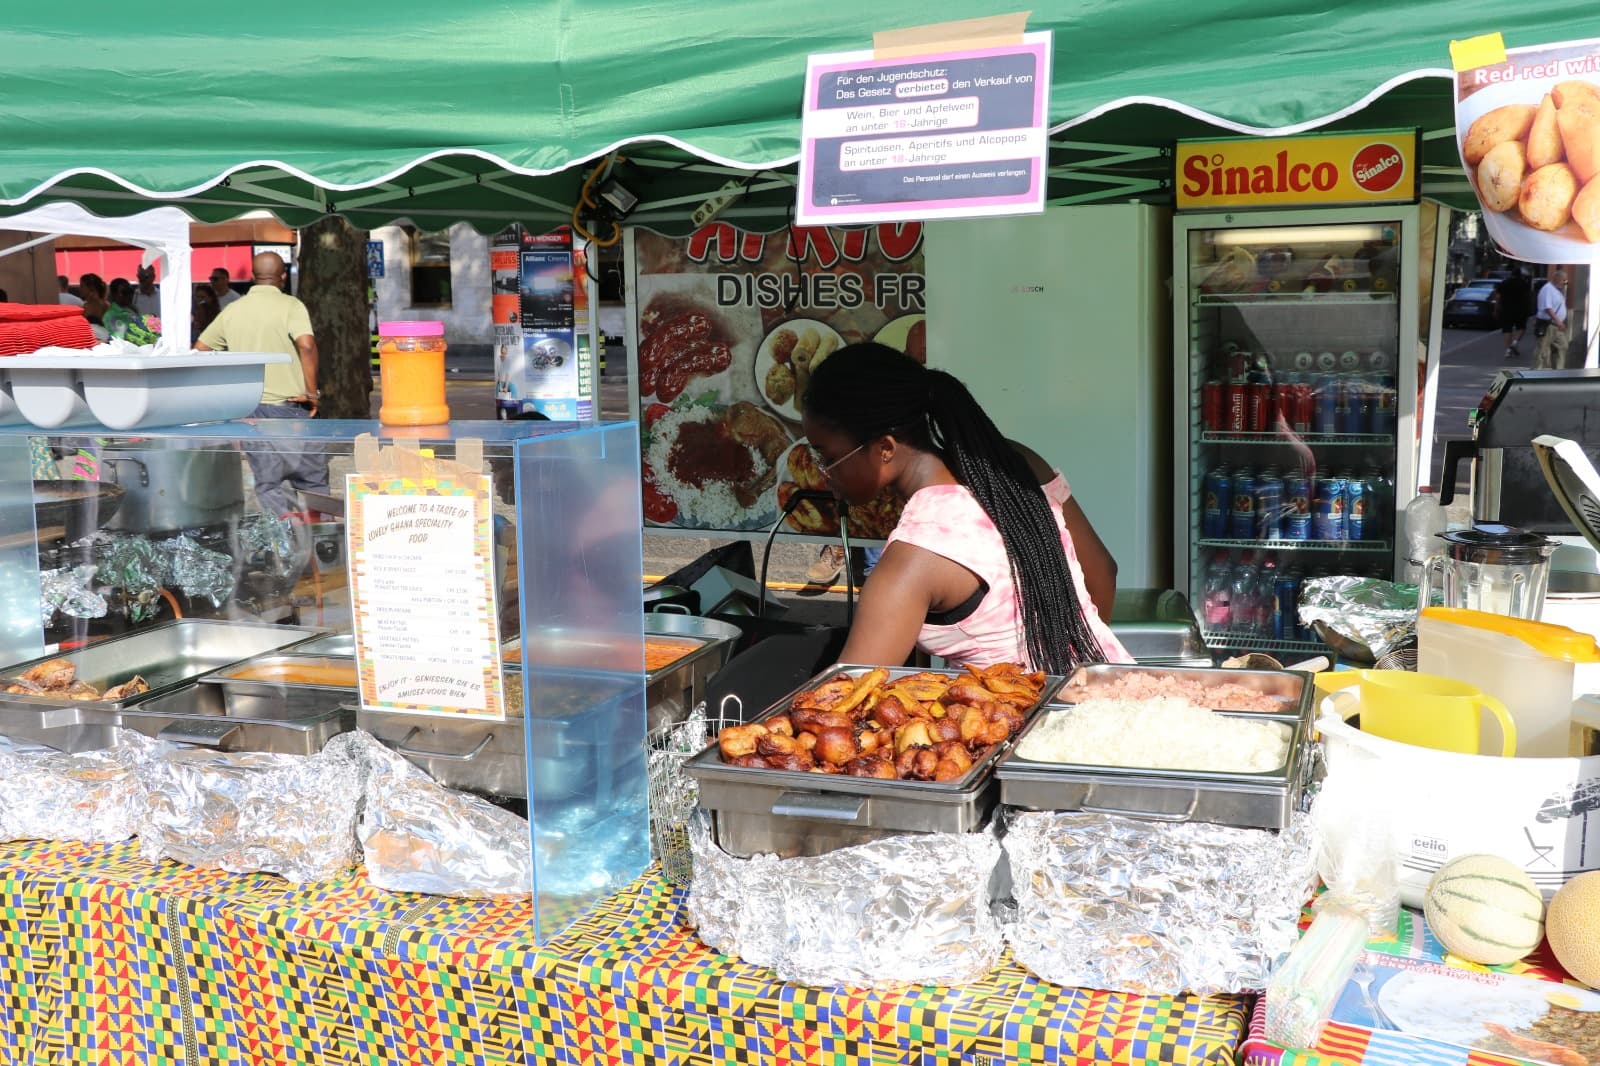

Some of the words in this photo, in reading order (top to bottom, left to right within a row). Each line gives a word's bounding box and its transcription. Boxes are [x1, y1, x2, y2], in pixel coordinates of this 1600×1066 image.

[837, 76, 854, 86] Für
[856, 74, 874, 84] den
[877, 68, 948, 83] Jugendschutz:
[1474, 66, 1514, 84] Red
[1523, 60, 1559, 79] red
[836, 89, 855, 99] Das
[858, 88, 892, 97] Gesetz
[898, 82, 946, 94] verbietet
[952, 80, 971, 89] den
[974, 75, 1013, 87] Verkauf
[1014, 74, 1033, 83] von
[846, 110, 875, 120] Wein,
[879, 108, 900, 117] Bier
[903, 105, 922, 116] und
[925, 103, 975, 114] Apfelwein
[861, 122, 888, 132] unter
[844, 143, 904, 156] Spirituosen,
[908, 139, 953, 151] Aperitifs
[955, 136, 976, 147] und
[978, 134, 1028, 146] Alcopops
[844, 160, 856, 168] an
[859, 157, 887, 167] unter
[1356, 154, 1400, 183] Sinalco
[1183, 150, 1339, 198] Sinalco
[717, 274, 864, 308] DISHES
[387, 503, 417, 519] WELCOME
[420, 503, 428, 512] TO
[430, 503, 435, 511] A
[437, 504, 457, 515] TASTE
[458, 508, 470, 517] OF
[368, 524, 389, 541] LOVELY
[391, 518, 414, 533] GHANA
[415, 517, 455, 529] SPECIALITY
[378, 679, 400, 694] ENJOY
[415, 675, 454, 684] GENIESSEN
[449, 689, 467, 699] BIEN
